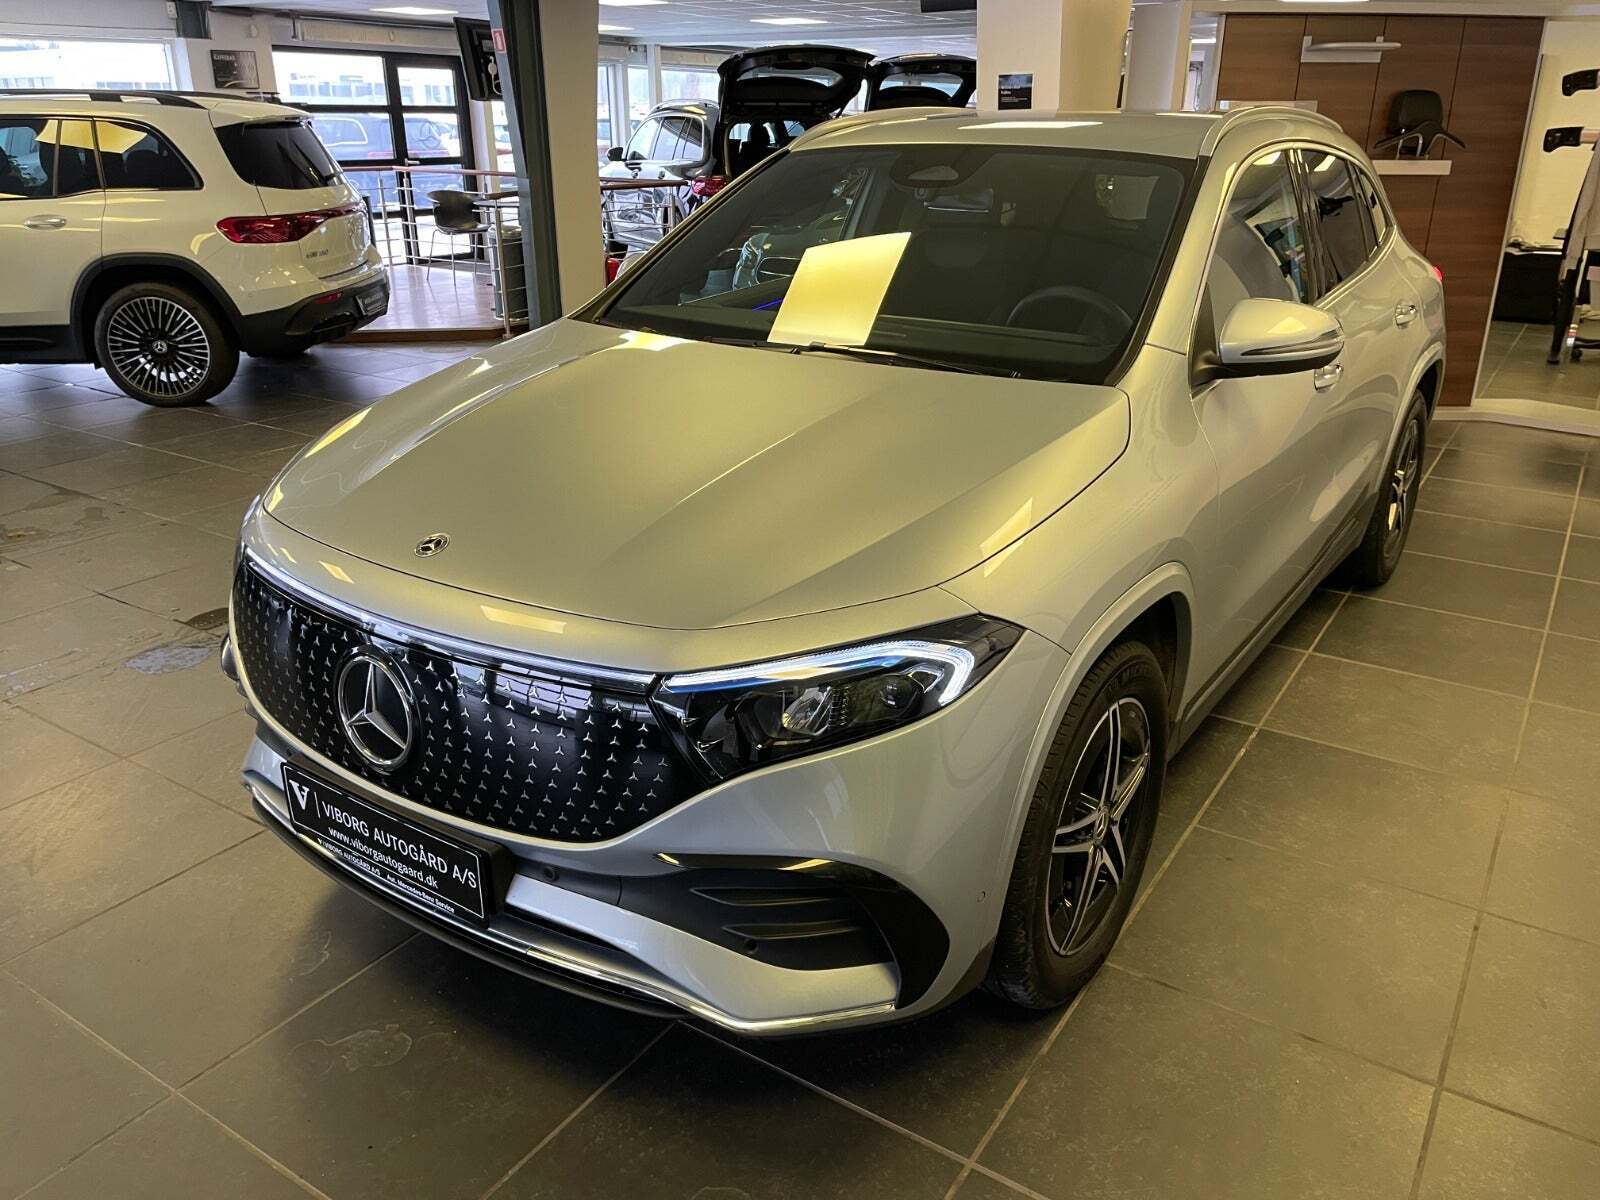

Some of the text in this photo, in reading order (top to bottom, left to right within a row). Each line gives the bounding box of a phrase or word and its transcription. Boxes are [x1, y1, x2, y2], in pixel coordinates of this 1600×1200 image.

[321, 800, 477, 888] VIBORG AUTOGÅRD A/S
[327, 826, 438, 889] www.viborgautogaard.dk
[435, 898, 455, 914] Service
